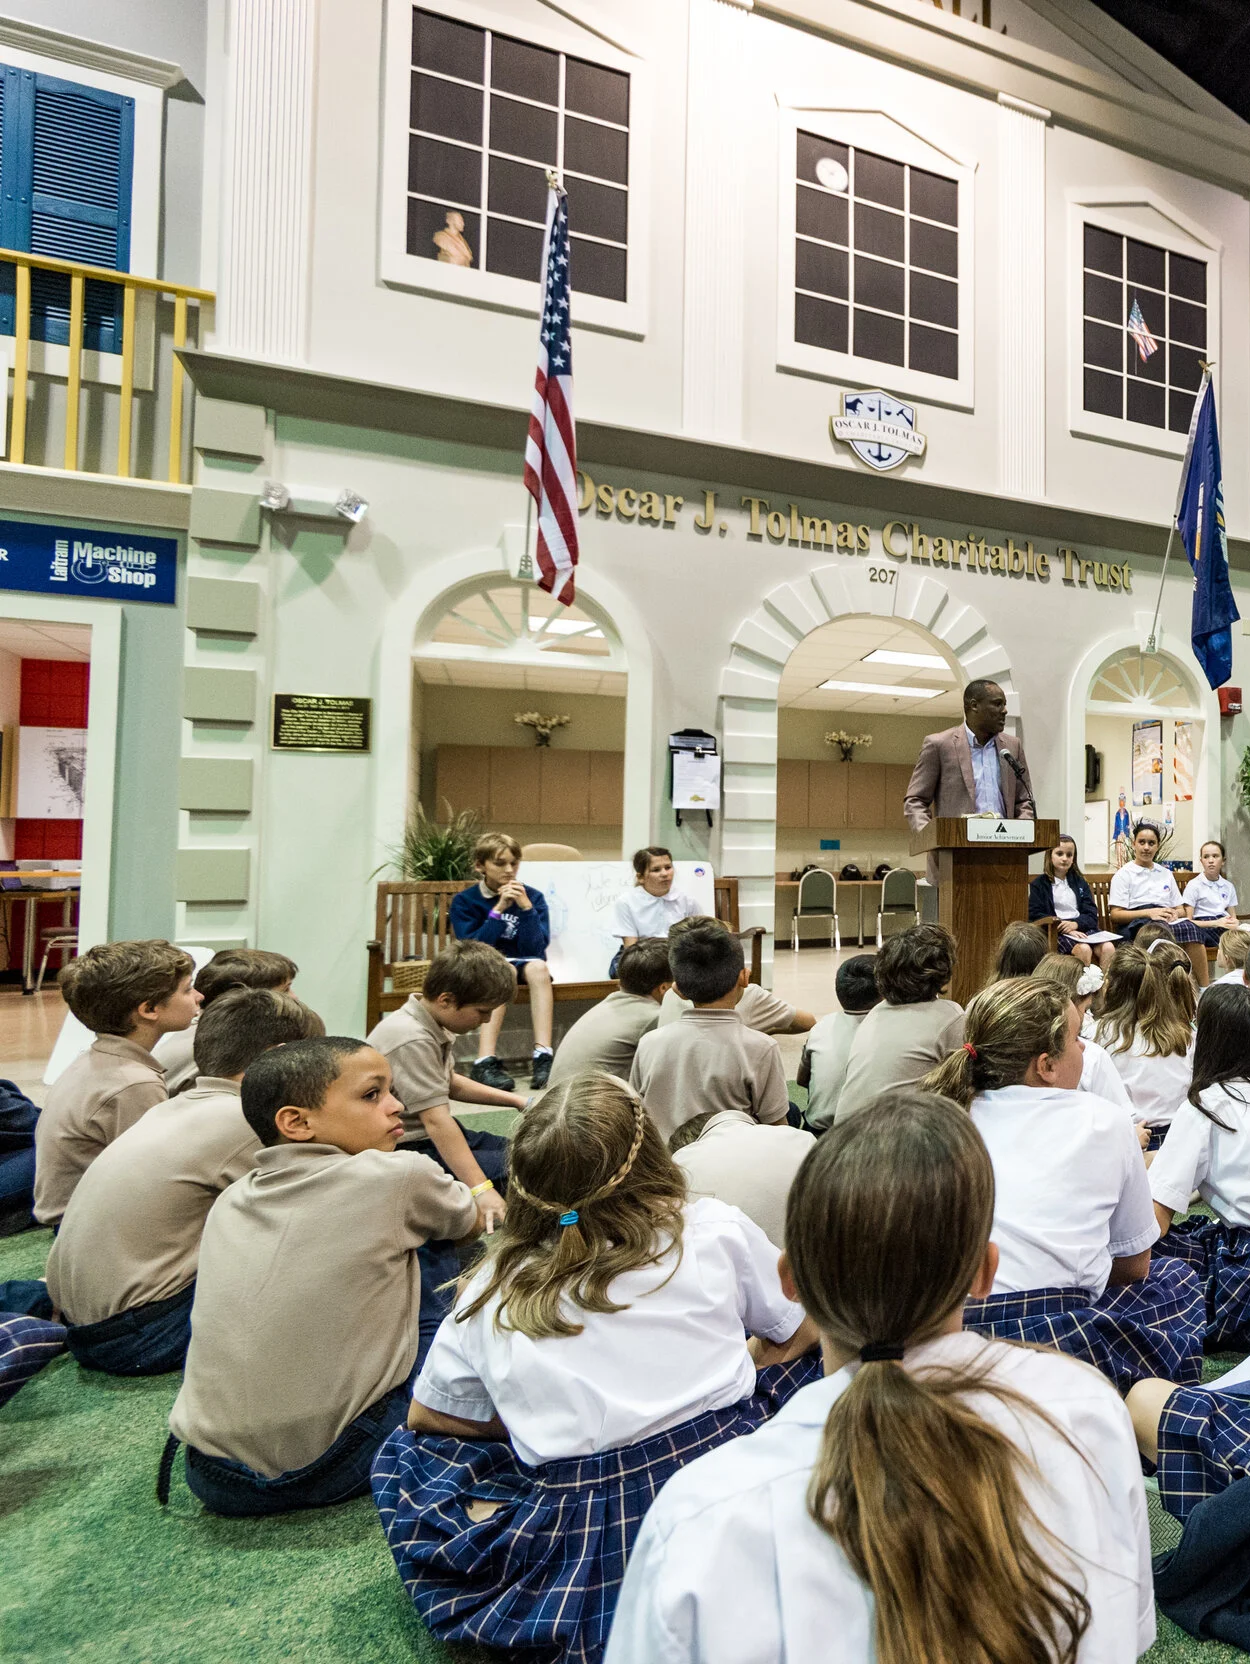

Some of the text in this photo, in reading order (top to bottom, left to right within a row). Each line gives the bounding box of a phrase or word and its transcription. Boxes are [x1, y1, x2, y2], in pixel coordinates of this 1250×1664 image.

[835, 420, 870, 430] OSCAR
[883, 425, 922, 445] TOLMAS
[694, 489, 728, 531] J.
[741, 496, 871, 551] Tolmas
[881, 521, 1050, 577] Charitable
[1058, 547, 1132, 589] Trust
[49, 539, 69, 582] Laitram
[73, 541, 157, 568] Machine
[108, 567, 157, 588] Shop
[868, 566, 897, 585] 207
